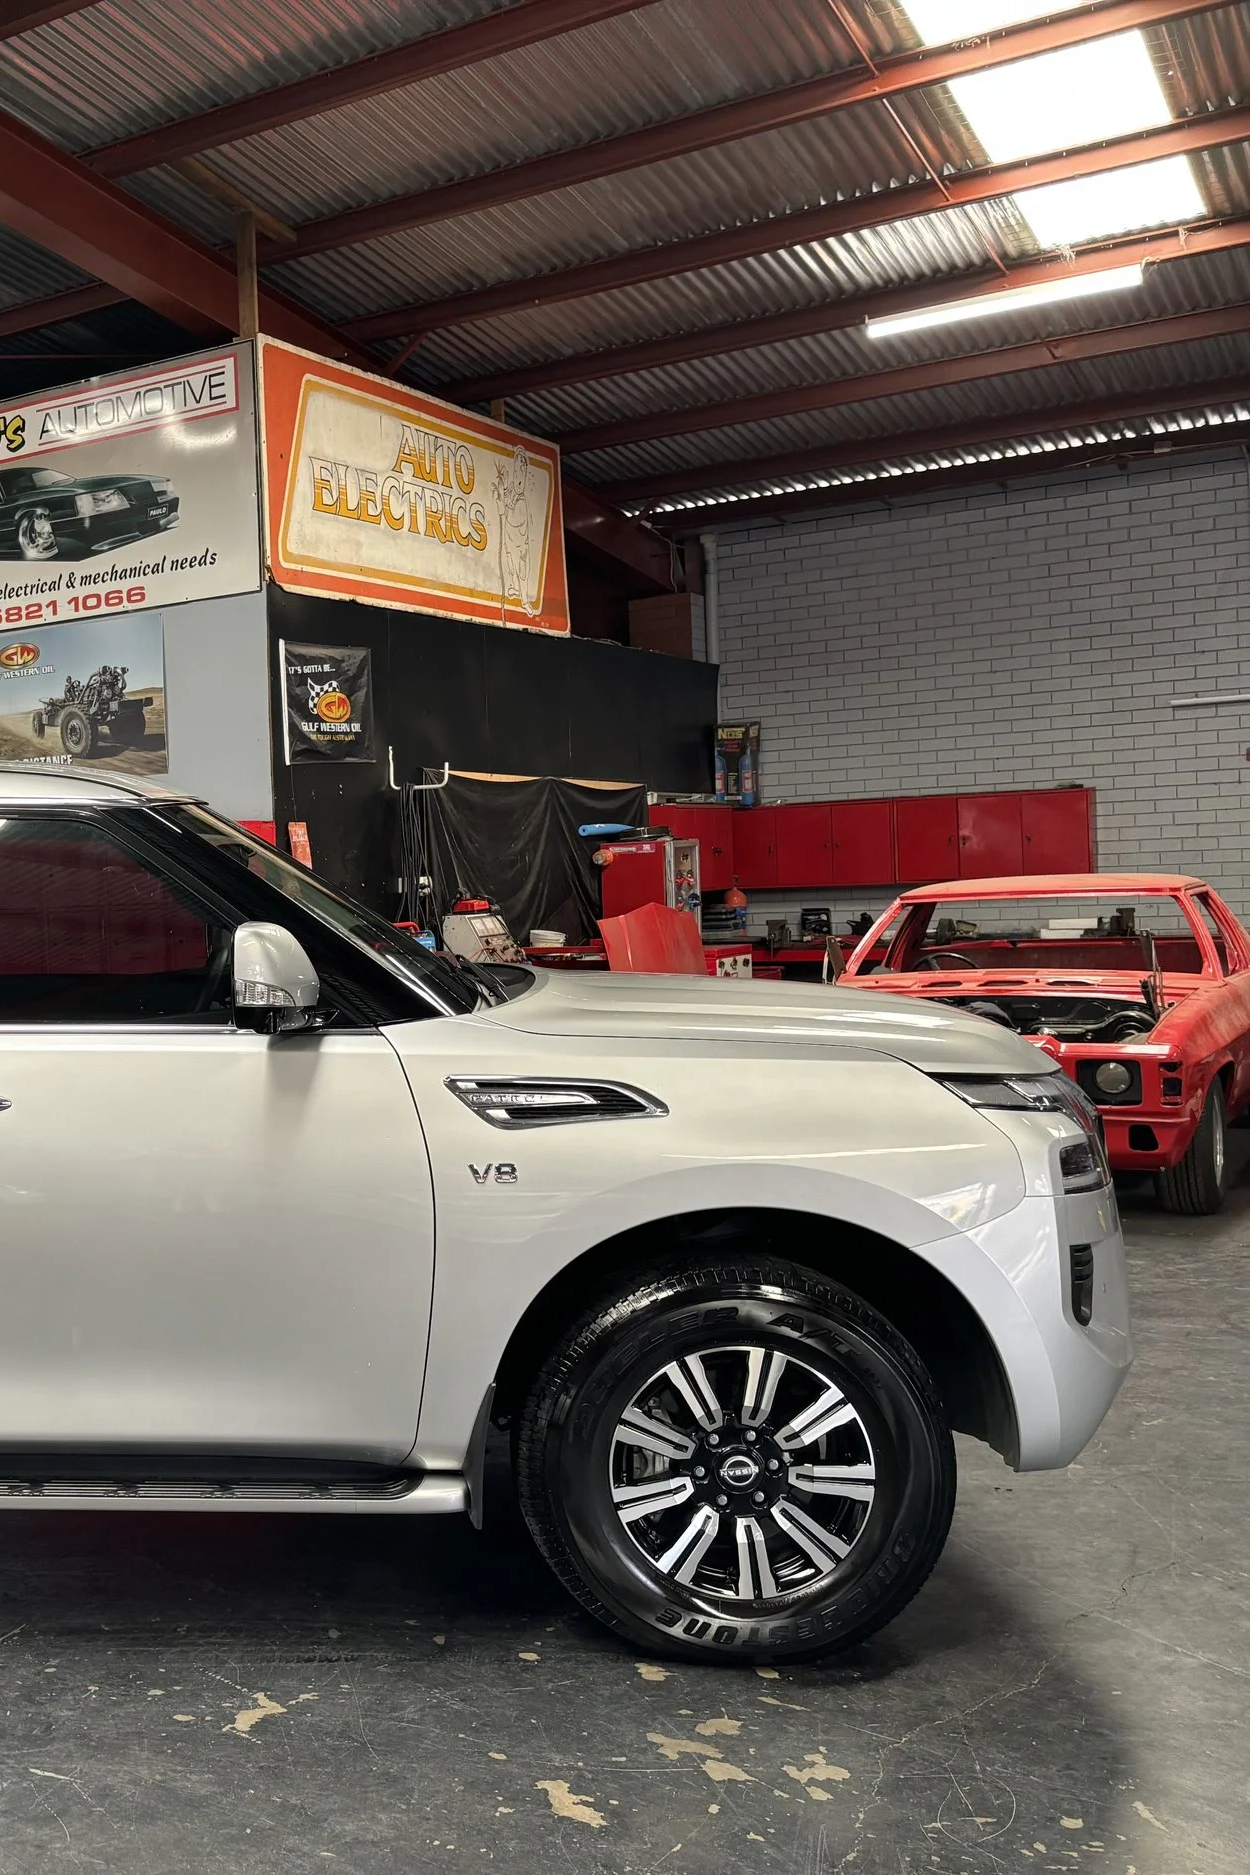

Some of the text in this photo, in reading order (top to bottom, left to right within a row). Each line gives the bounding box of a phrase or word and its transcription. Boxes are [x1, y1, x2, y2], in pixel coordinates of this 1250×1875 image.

[39, 370, 227, 440] AUTOMOTIVE
[391, 423, 476, 495] AUTO
[308, 455, 488, 552] ELECTRICS
[65, 571, 77, 589] &
[79, 555, 166, 588] mechanical
[169, 547, 218, 572] needs
[66, 585, 147, 614] 1066
[0, 646, 36, 667] GW
[3, 667, 40, 679] WESTERN
[41, 665, 55, 674] OIL
[288, 666, 302, 675] IT'S
[303, 664, 323, 674] GOTTA
[301, 722, 362, 733] GULF WESTERN OIL
[466, 1162, 519, 1184] V8
[719, 1466, 759, 1478] NISSAN
